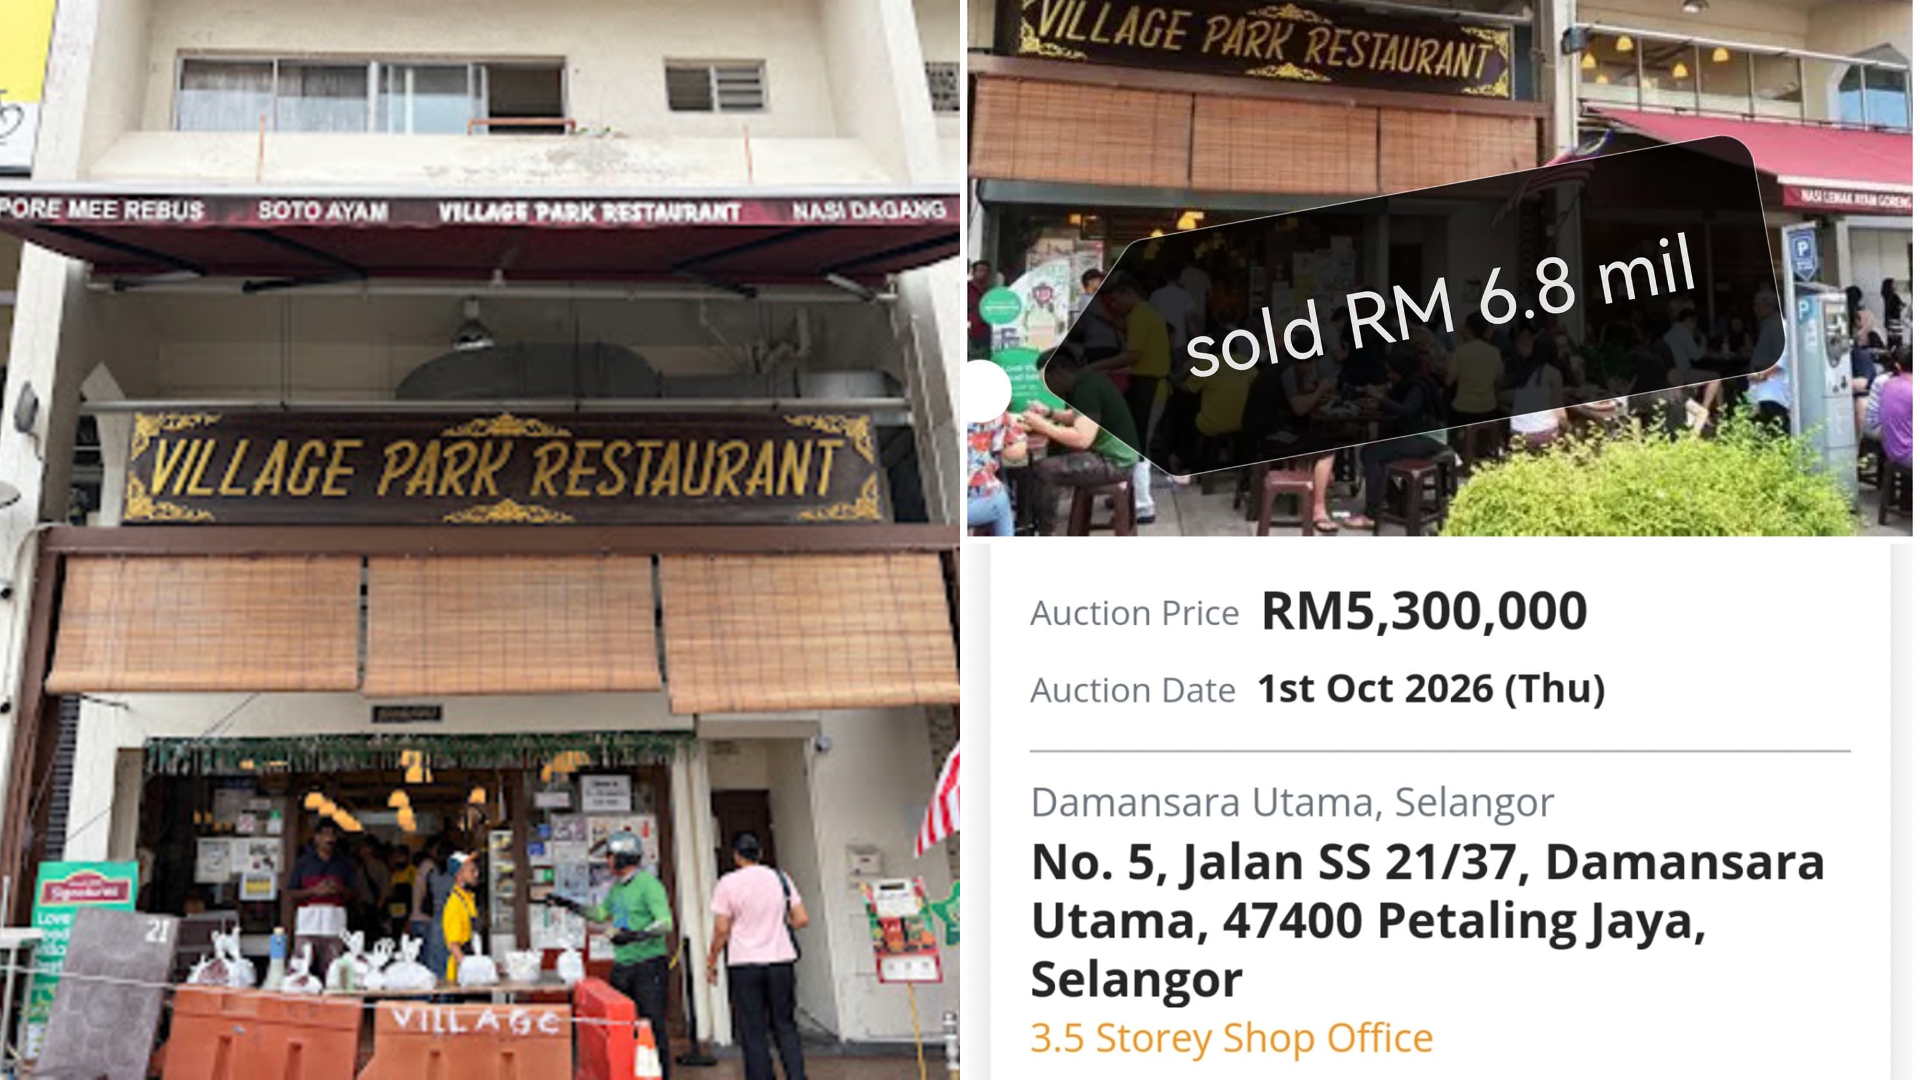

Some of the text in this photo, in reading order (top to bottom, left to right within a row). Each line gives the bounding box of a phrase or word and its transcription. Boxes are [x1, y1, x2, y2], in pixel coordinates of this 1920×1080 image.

[1039, 0, 1493, 79] VILLAGE PARK RESTAURANT
[68, 199, 119, 220] MEE
[124, 200, 205, 221] REBUS
[259, 200, 389, 221] SOTO AYAM
[439, 201, 742, 222] VILLAGE PARK RESTAURANT
[793, 200, 947, 221] NASI DAGANG
[1797, 241, 1809, 257] P
[151, 439, 845, 496] VILLAGE PARK RESTAURANT
[38, 913, 70, 925] Love
[145, 919, 170, 942] 21
